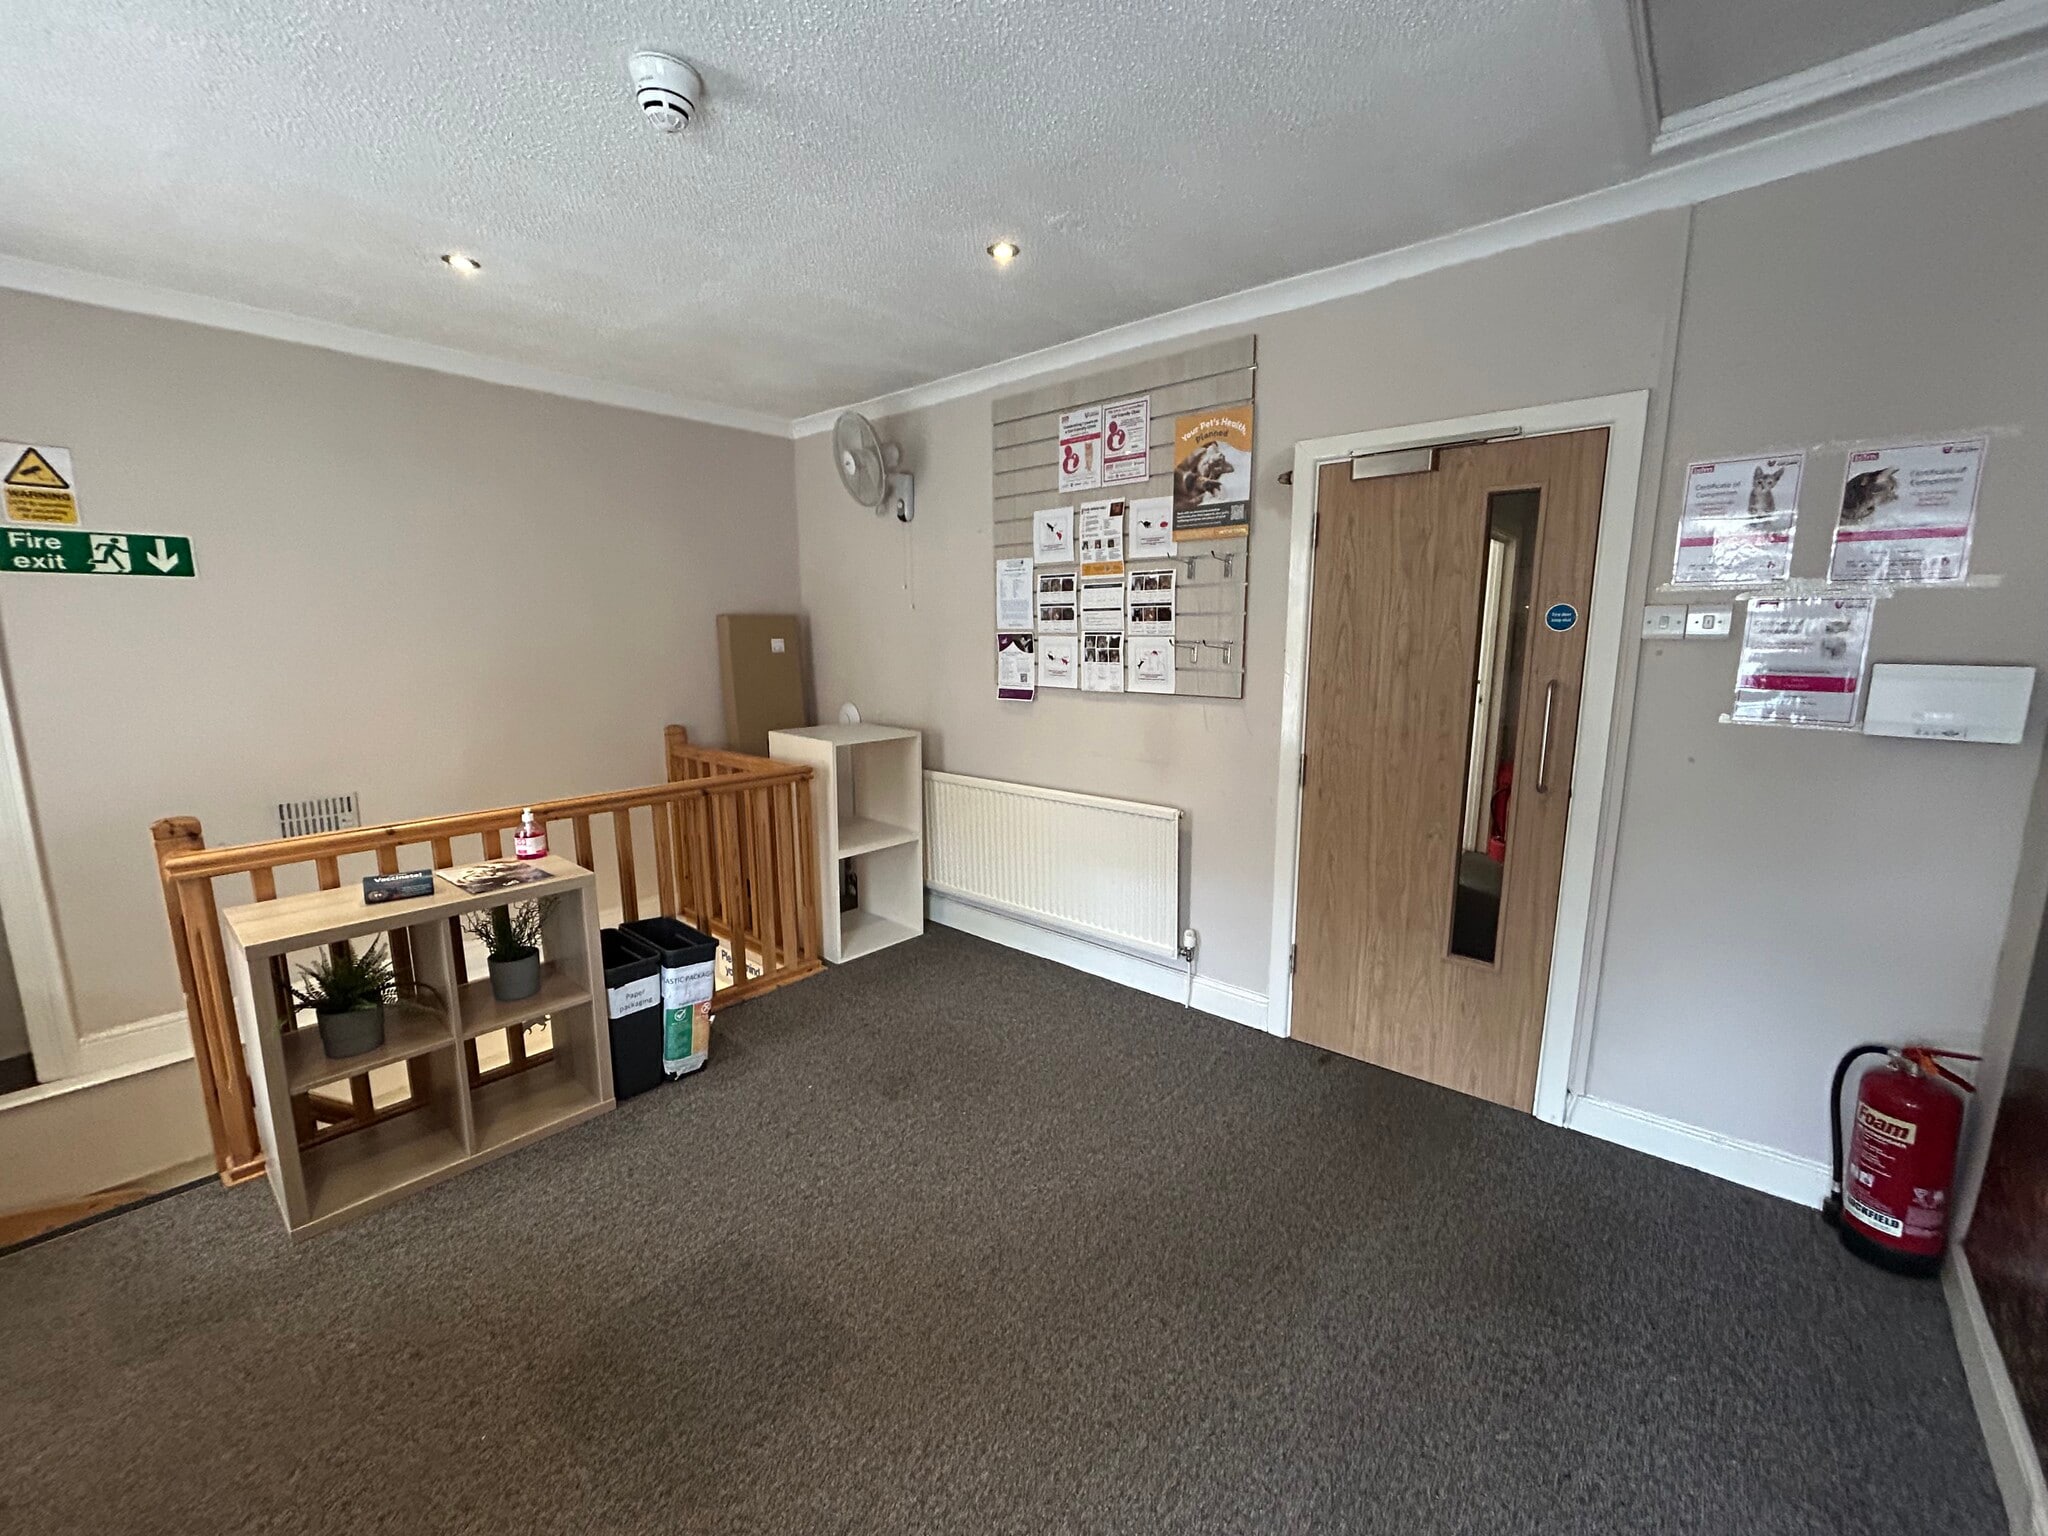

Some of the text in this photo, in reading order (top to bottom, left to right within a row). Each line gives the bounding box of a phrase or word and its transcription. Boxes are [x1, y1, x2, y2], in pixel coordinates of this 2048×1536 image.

[1181, 426, 1199, 441] Your
[1199, 418, 1220, 430] Pet's
[1195, 430, 1229, 443] planned
[1695, 482, 1731, 491] Certificate
[6, 489, 71, 501] WARNING
[7, 531, 62, 549] Fire
[13, 553, 67, 570] exit
[373, 872, 423, 883] Vaccinate!
[625, 988, 646, 1000] Paper
[619, 996, 653, 1014] packaging
[1859, 1104, 1909, 1140] Foam
